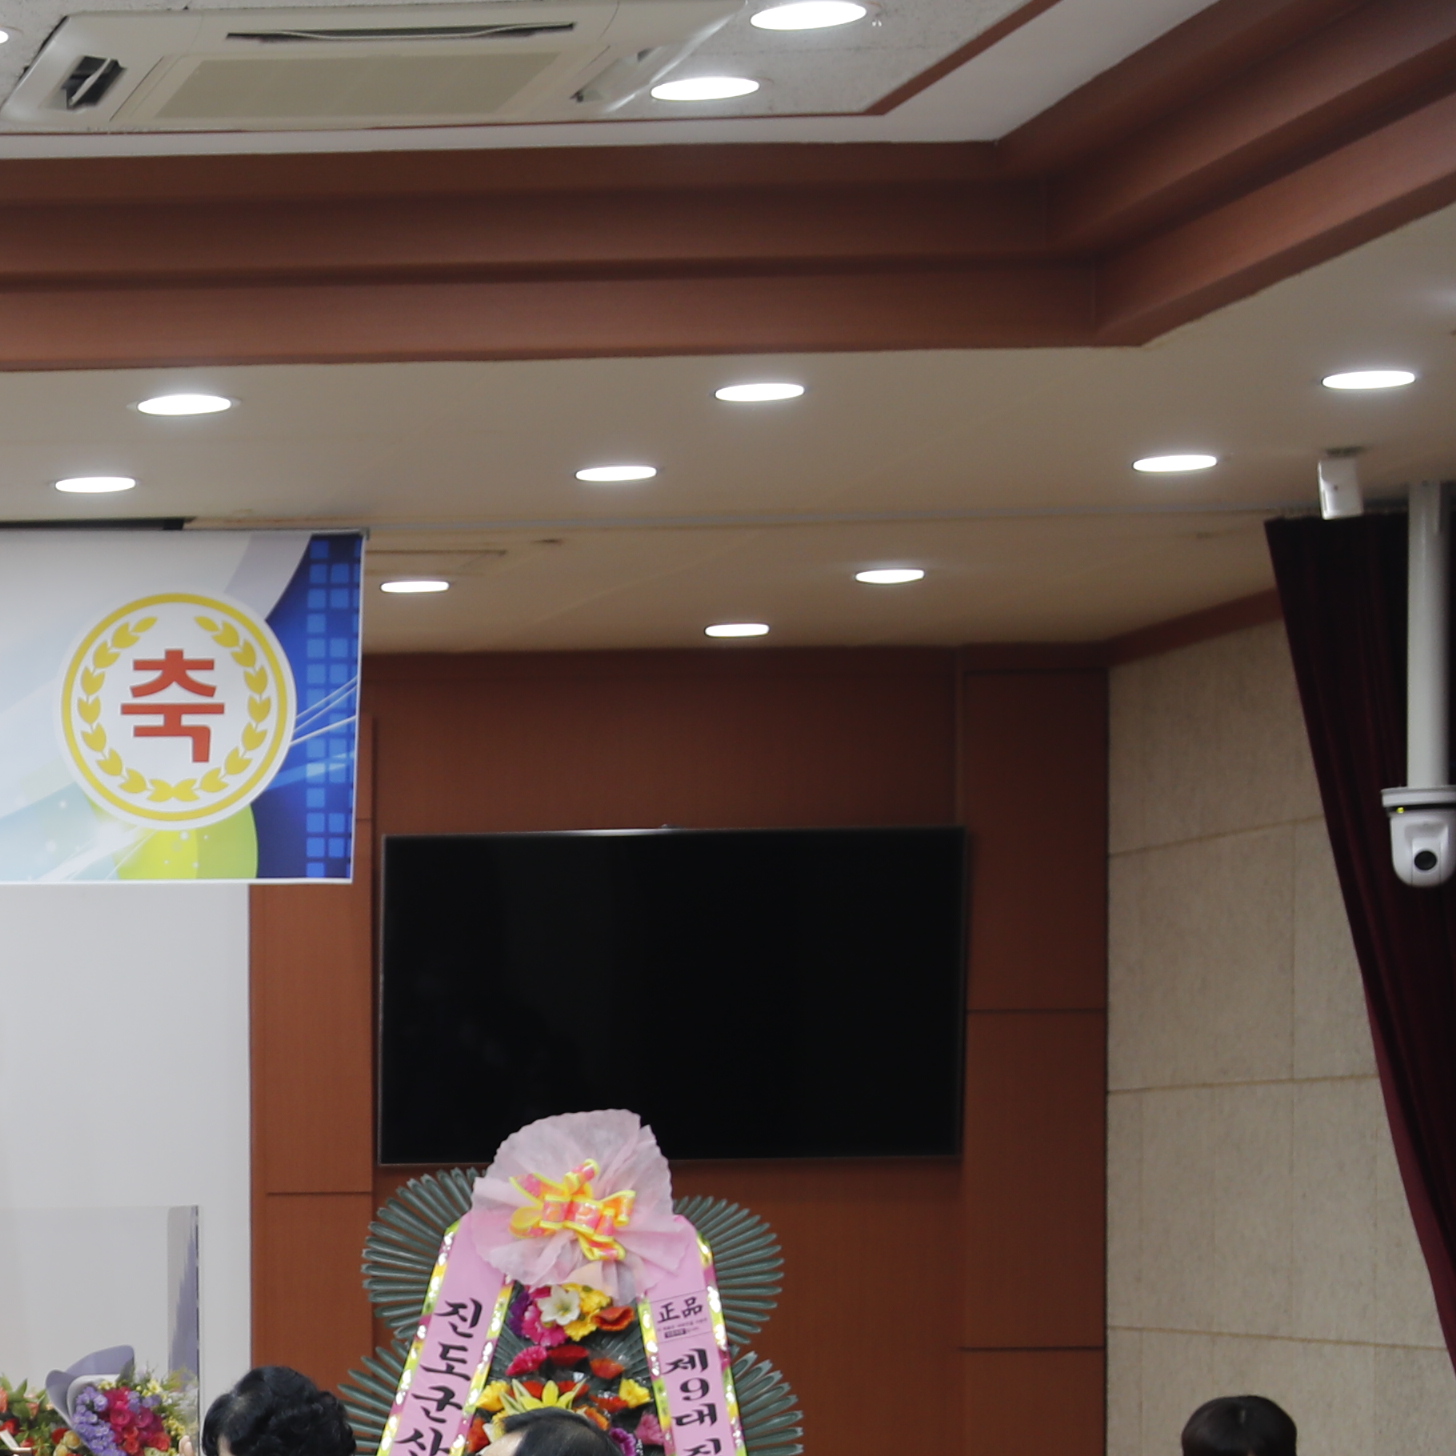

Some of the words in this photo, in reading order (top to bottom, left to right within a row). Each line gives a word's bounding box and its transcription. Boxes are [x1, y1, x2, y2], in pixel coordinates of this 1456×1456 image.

[120, 648, 225, 763] 축
[657, 1296, 703, 1324] 正品
[663, 1348, 718, 1428] 제9대
